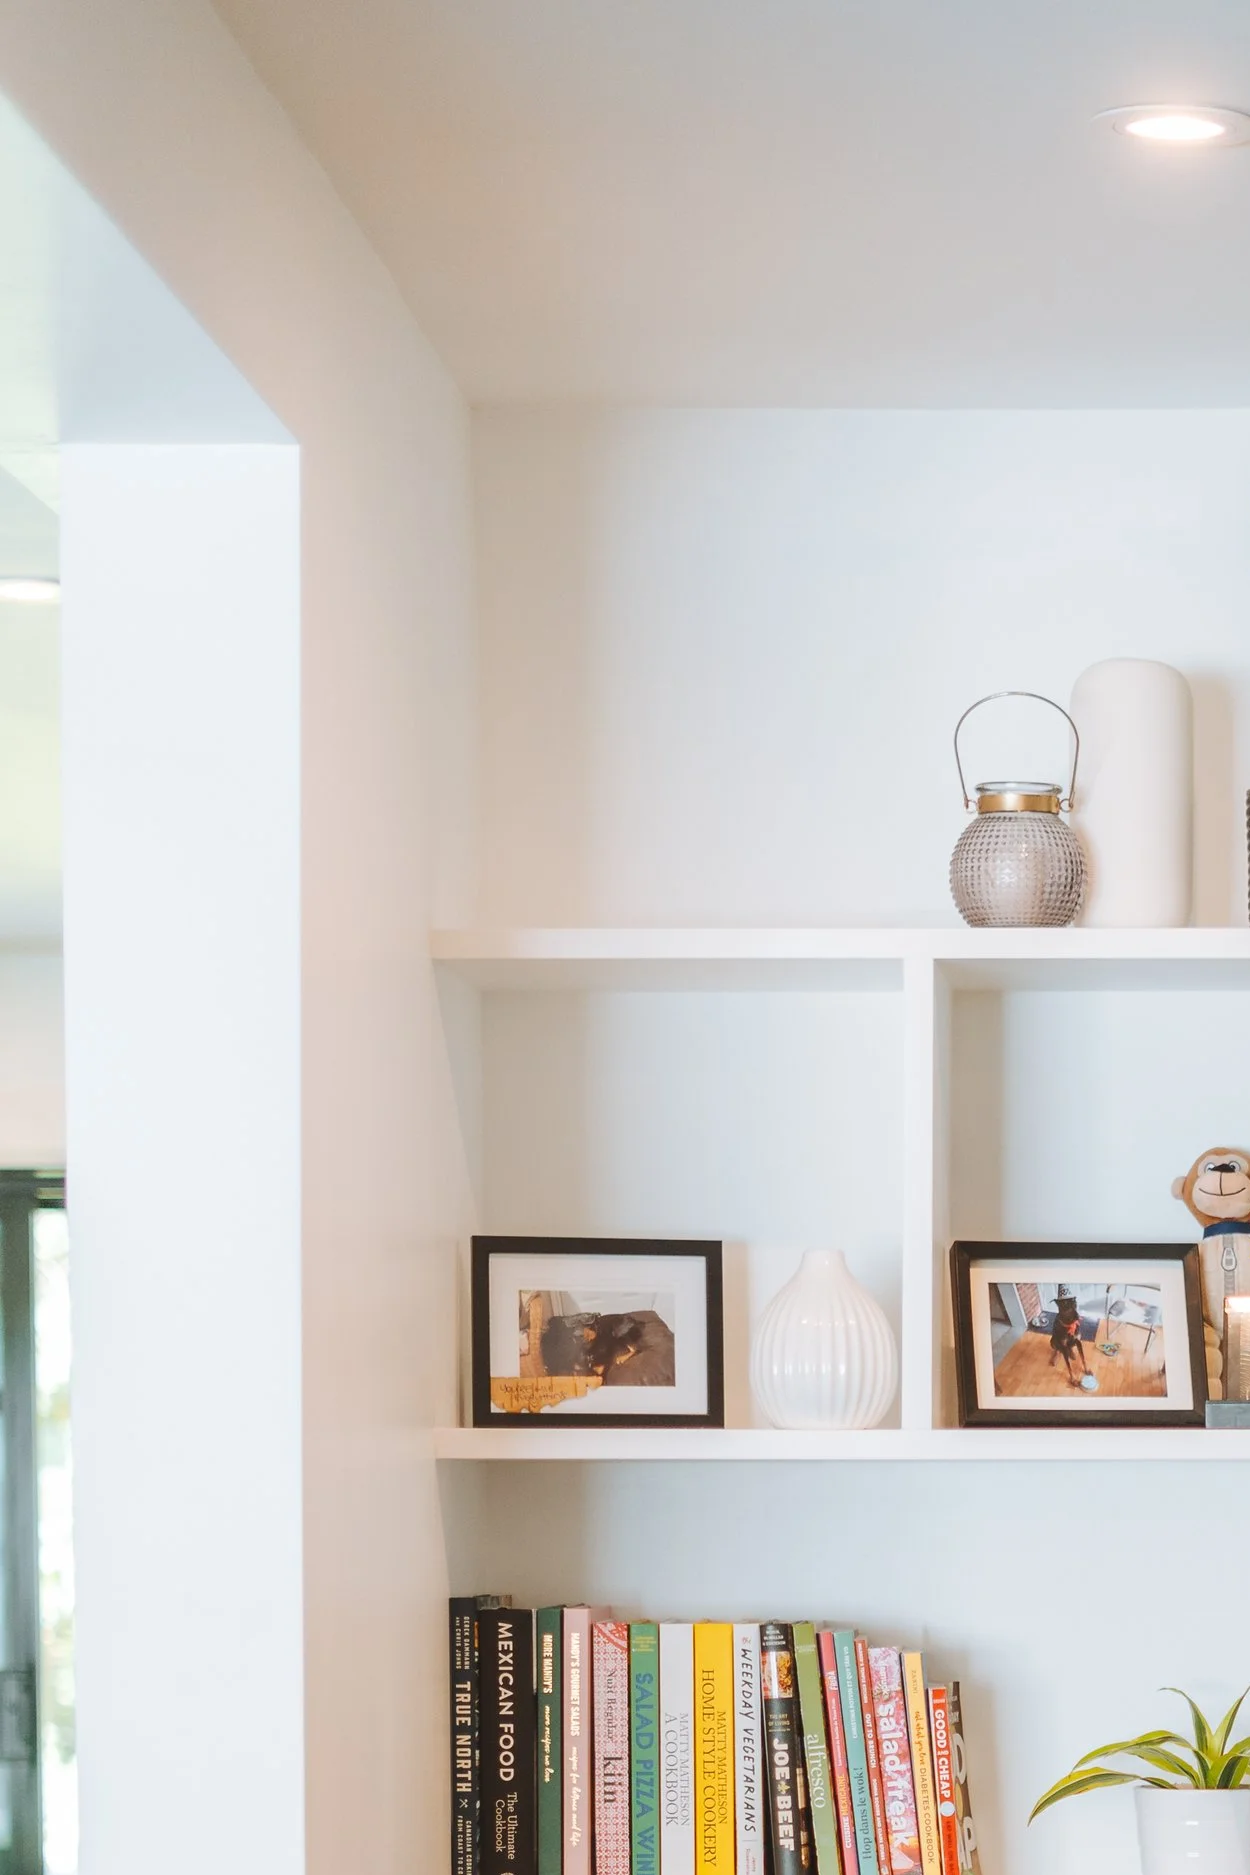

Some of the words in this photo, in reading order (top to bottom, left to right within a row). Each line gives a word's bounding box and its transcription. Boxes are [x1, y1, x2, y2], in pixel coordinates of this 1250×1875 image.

[543, 1634, 553, 1658] MORE
[570, 1632, 580, 1667] MANDY'S
[497, 1622, 514, 1715] MEXICAN
[543, 1658, 553, 1694] MANDY'S
[570, 1668, 580, 1705] GOURMET
[739, 1648, 755, 1721] WEEKDAY
[455, 1681, 471, 1726] TRUE
[636, 1672, 654, 1750] SALAD
[702, 1669, 715, 1722] HOME
[570, 1706, 580, 1737] SALADS
[604, 1697, 617, 1741] Regular
[665, 1713, 678, 1725] A
[679, 1712, 689, 1756] MATTY
[717, 1711, 727, 1754] MATTY
[864, 1713, 872, 1727] OUT
[866, 1729, 873, 1739] TO
[935, 1709, 947, 1749] GOOD
[456, 1735, 472, 1792] NORTH
[499, 1723, 515, 1782] FOOD
[702, 1728, 716, 1780] STYLE
[773, 1738, 791, 1781] JOE
[806, 1734, 826, 1809] alfresco
[867, 1740, 877, 1769] BRUNCH
[603, 1756, 622, 1804] kiin
[636, 1759, 655, 1819] PIZZA
[665, 1730, 679, 1826] COOKBOOK
[680, 1758, 690, 1826] MATHESON
[717, 1756, 728, 1824] MATHESON
[743, 1728, 756, 1833] VEGETARIANS
[837, 1773, 849, 1816] MEXICAINE
[919, 1767, 930, 1811] DIABETES
[938, 1755, 950, 1798] CHEAP
[507, 1792, 518, 1812] The
[776, 1795, 795, 1851] BEEF
[856, 1796, 867, 1807] le
[858, 1809, 870, 1835] dans
[495, 1799, 506, 1853] Cookbook
[507, 1814, 518, 1860] Ultimate
[703, 1786, 717, 1867] COOKERY
[842, 1816, 853, 1849] CUISINE
[923, 1812, 935, 1864] COOKBOOK
[861, 1837, 873, 1860] Hop
